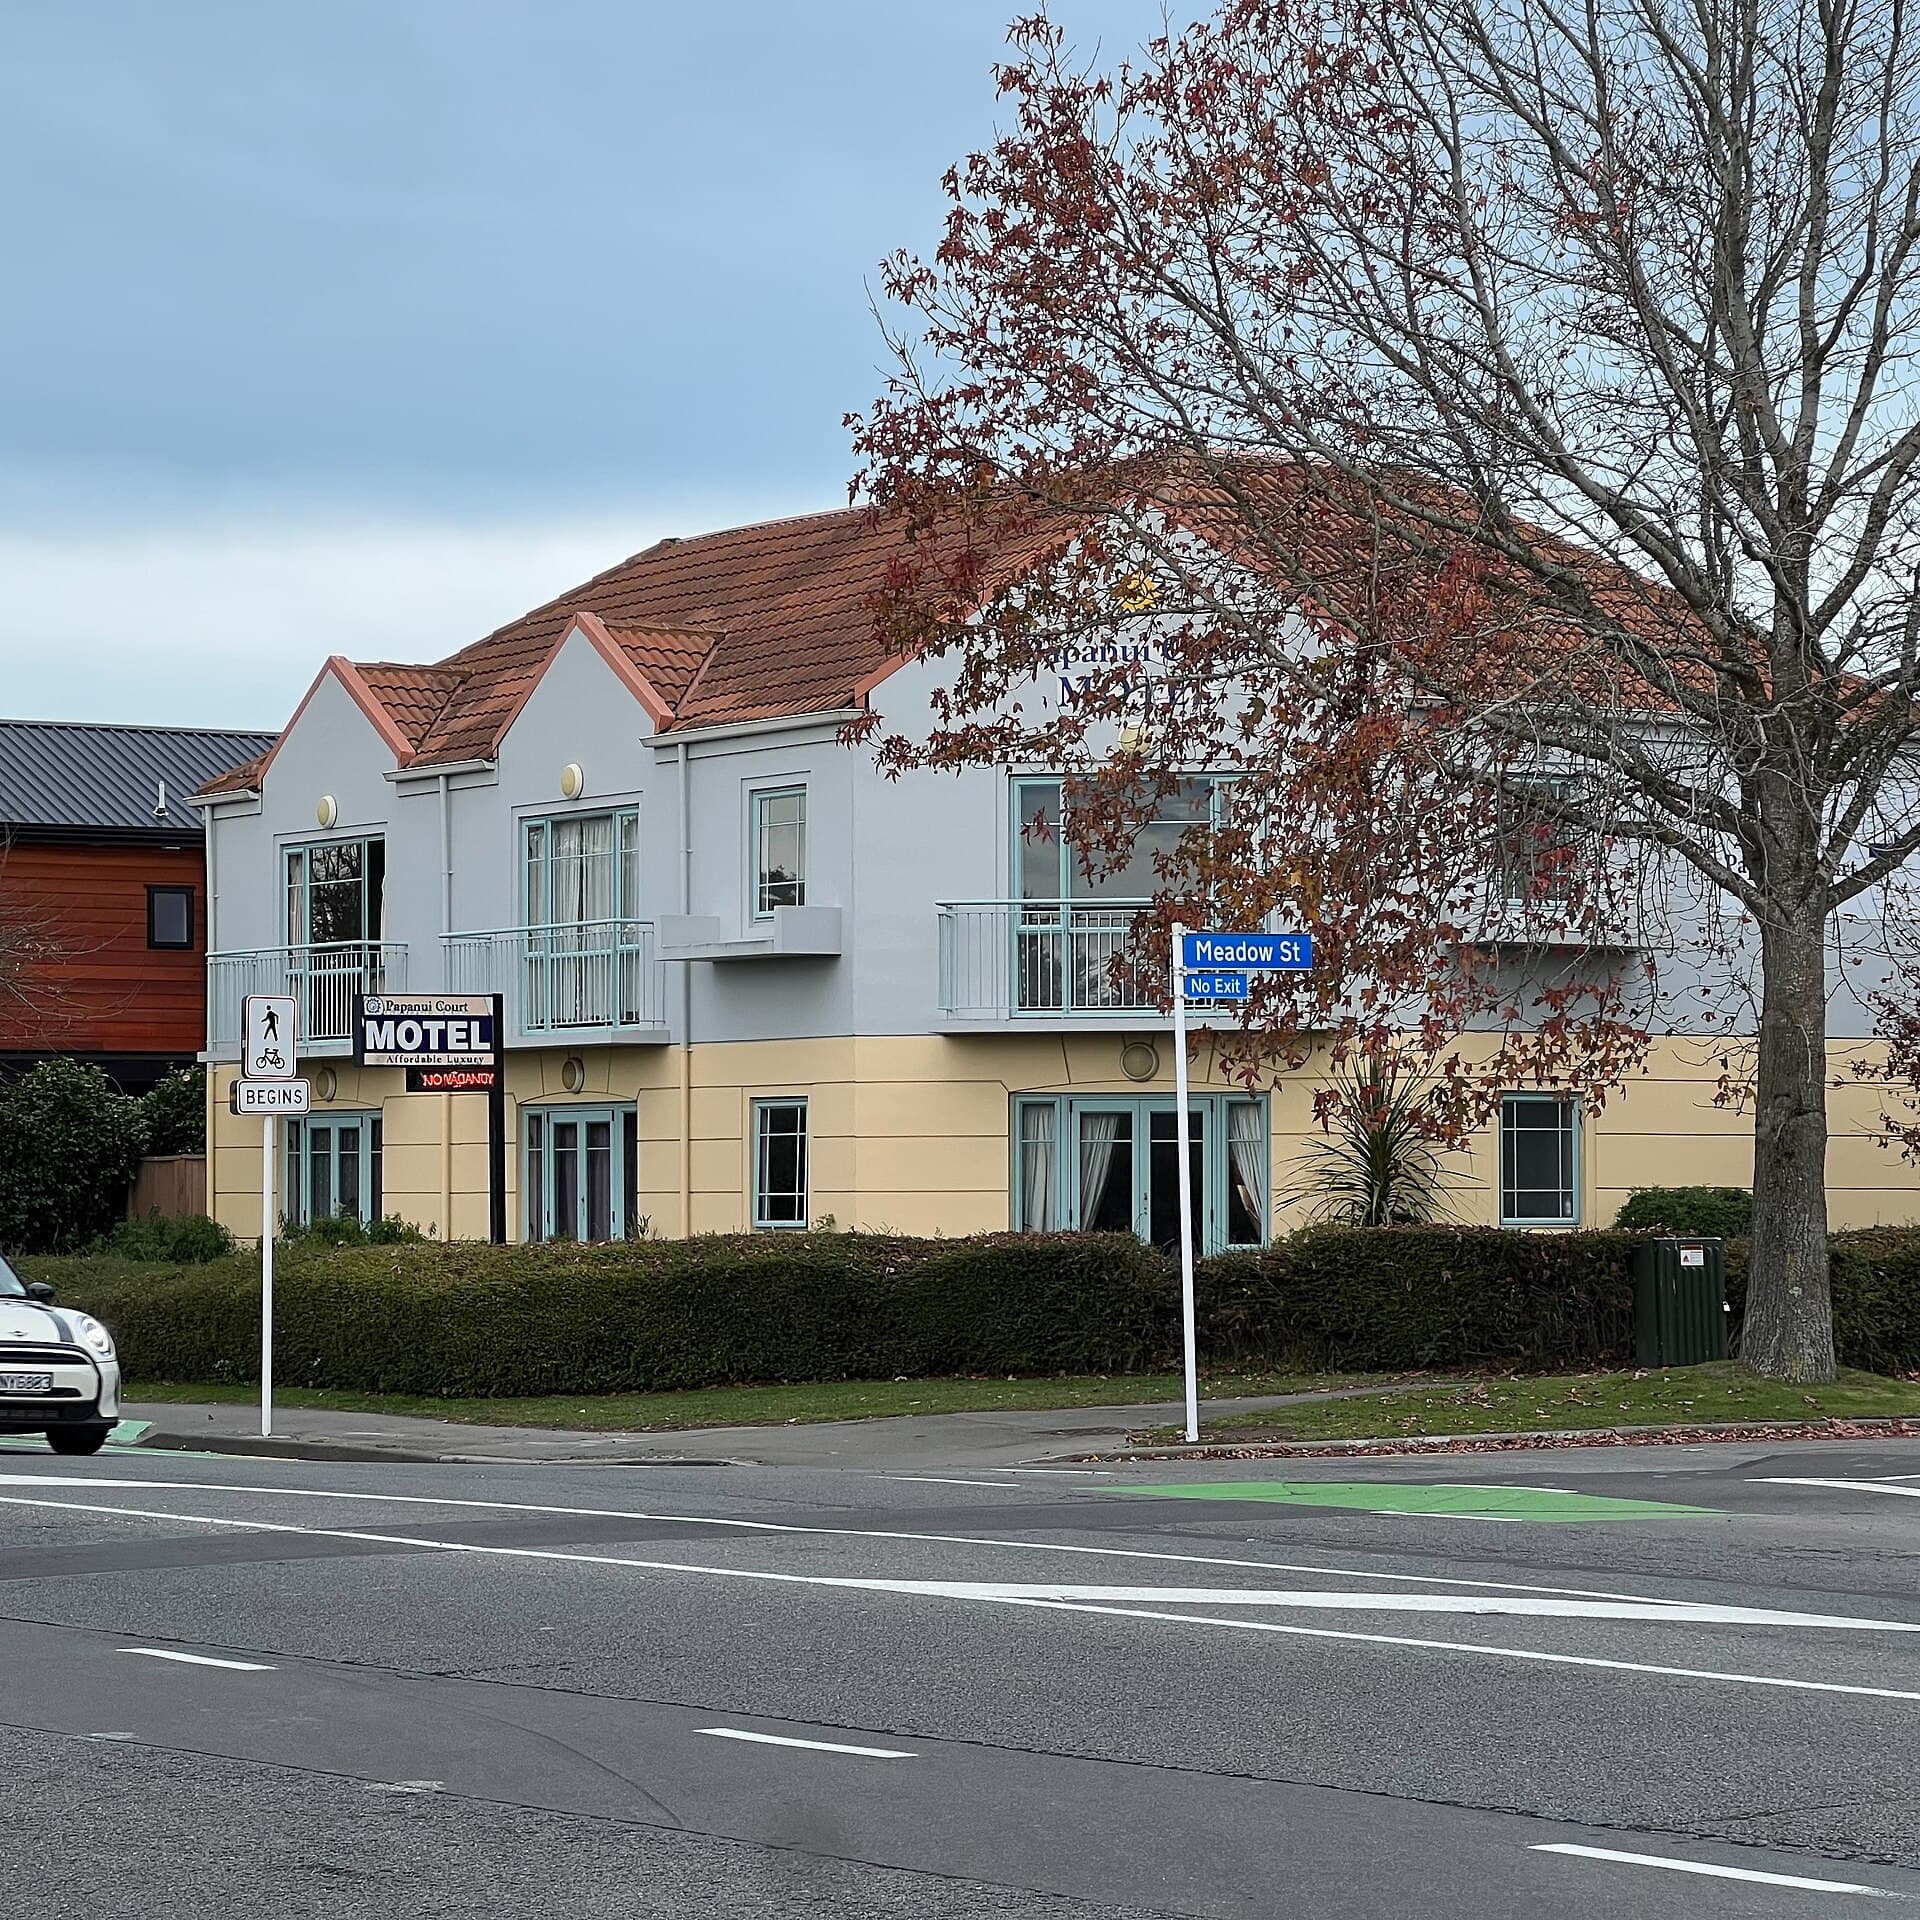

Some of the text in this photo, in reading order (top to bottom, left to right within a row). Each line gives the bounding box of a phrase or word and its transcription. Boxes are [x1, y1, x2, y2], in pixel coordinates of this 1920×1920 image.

[1028, 633, 1152, 671] panui
[1196, 940, 1301, 962] Meadow St
[1191, 978, 1241, 994] No Exit
[385, 1000, 469, 1014] Papanui Court
[365, 1020, 491, 1051] MOTEL
[386, 1055, 484, 1066] Affordable Luxury
[422, 1072, 494, 1087] NO VACANCY
[246, 1089, 303, 1105] BEGINS
